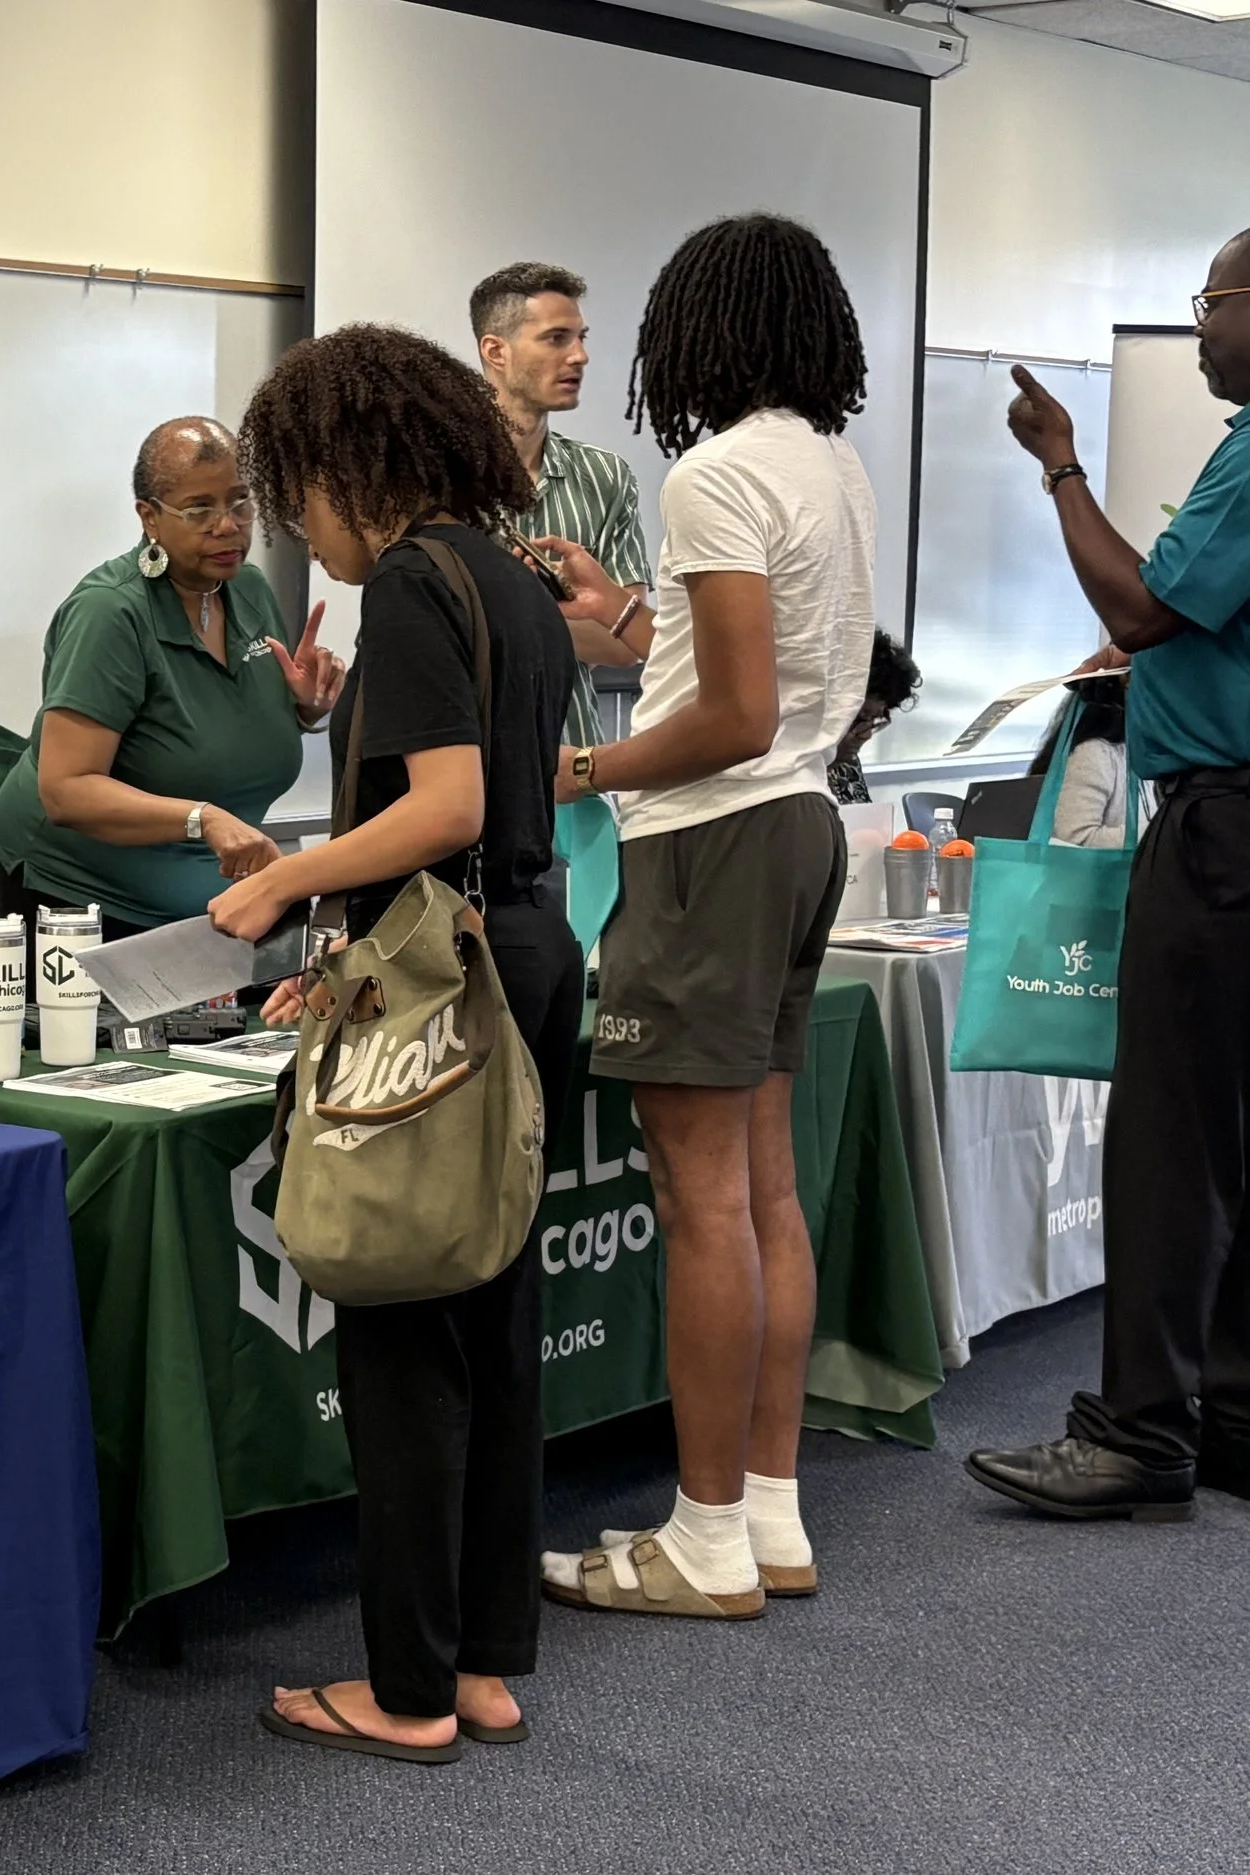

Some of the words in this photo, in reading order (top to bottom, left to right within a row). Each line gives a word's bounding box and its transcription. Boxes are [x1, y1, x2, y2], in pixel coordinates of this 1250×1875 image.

[1007, 974, 1050, 994] Youth
[1053, 980, 1085, 996] Job
[598, 1013, 641, 1043] 1993
[340, 1127, 359, 1144] FL
